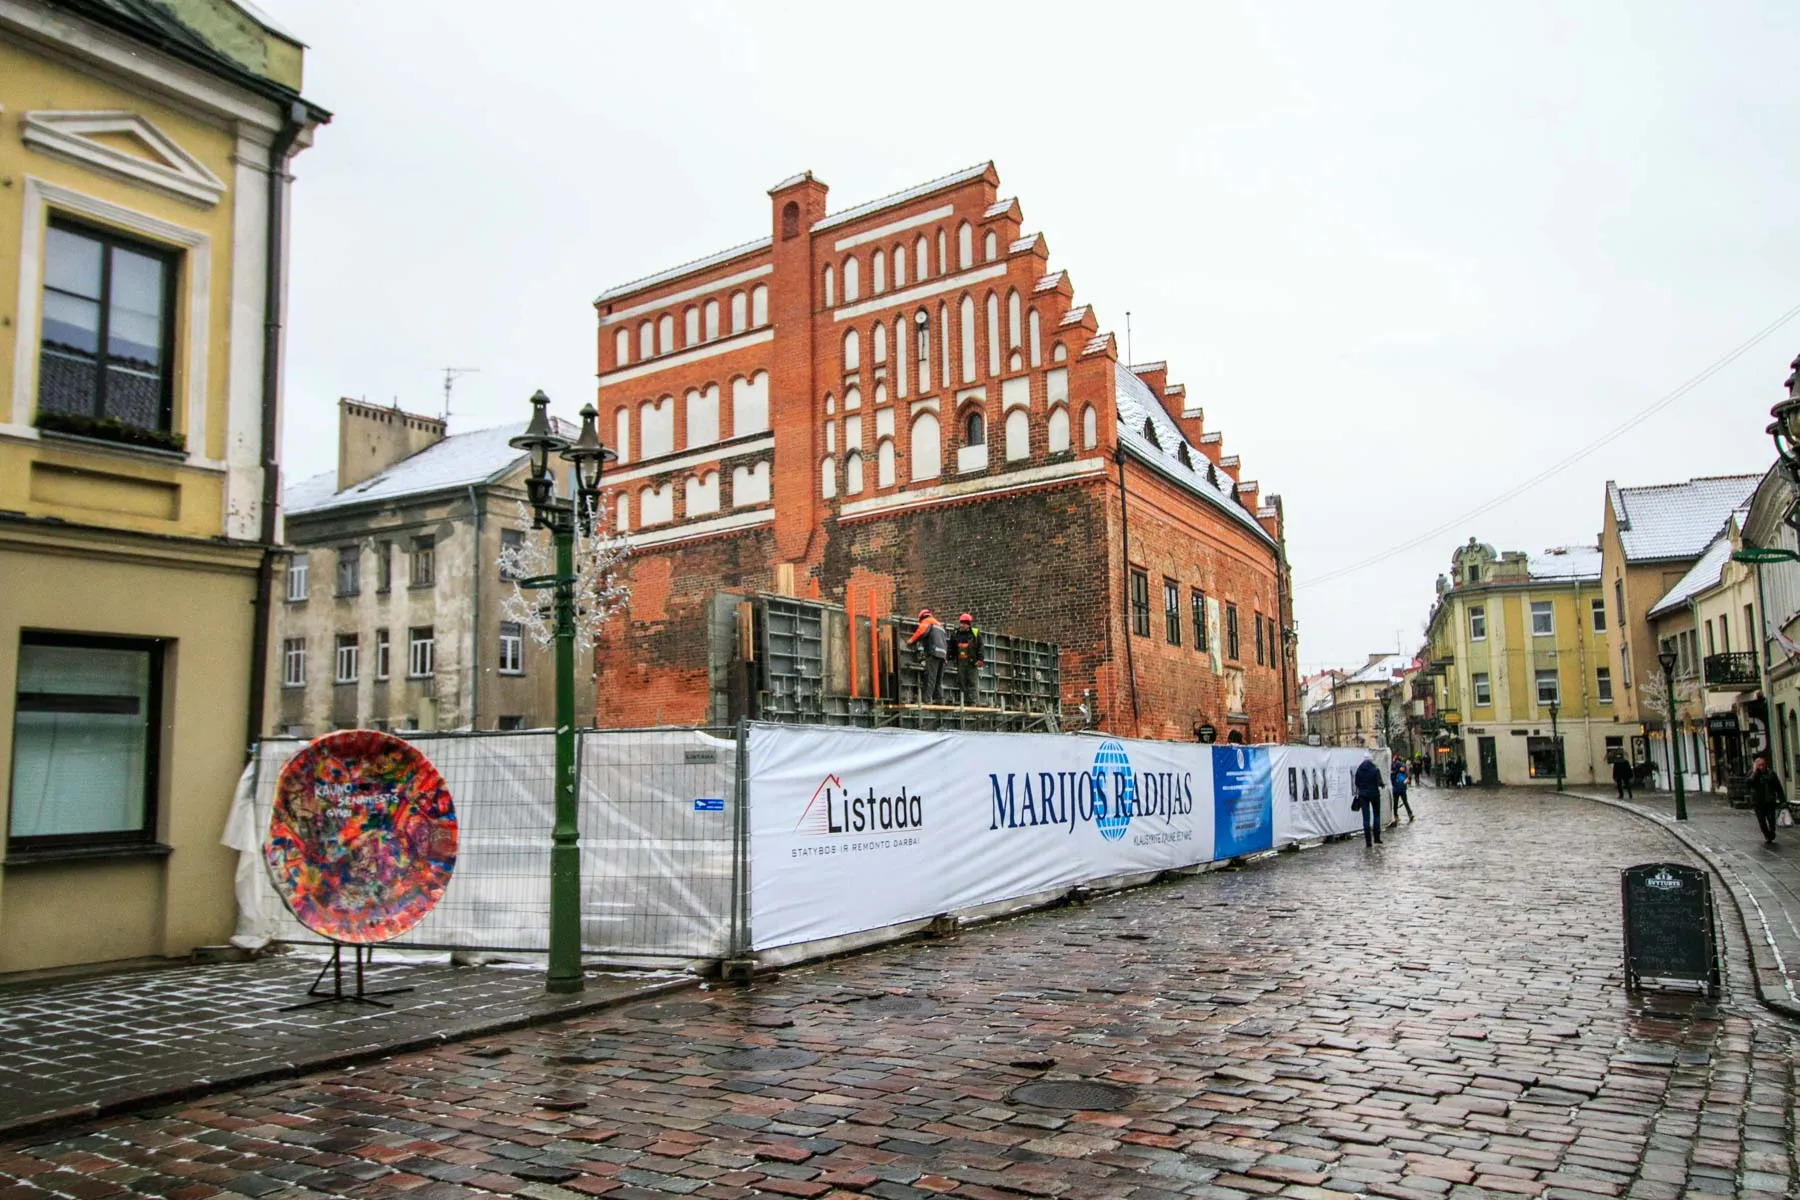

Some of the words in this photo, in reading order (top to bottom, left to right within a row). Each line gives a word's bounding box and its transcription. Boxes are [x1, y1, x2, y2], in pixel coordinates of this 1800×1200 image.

[826, 785, 923, 834] Listada
[988, 770, 1108, 834] MARIJOS
[1114, 771, 1193, 826] RADIJAS
[791, 845, 837, 858] STATYBOS
[840, 843, 849, 853] IR
[852, 840, 891, 852] REMONTO
[893, 836, 921, 848] DARBAI
